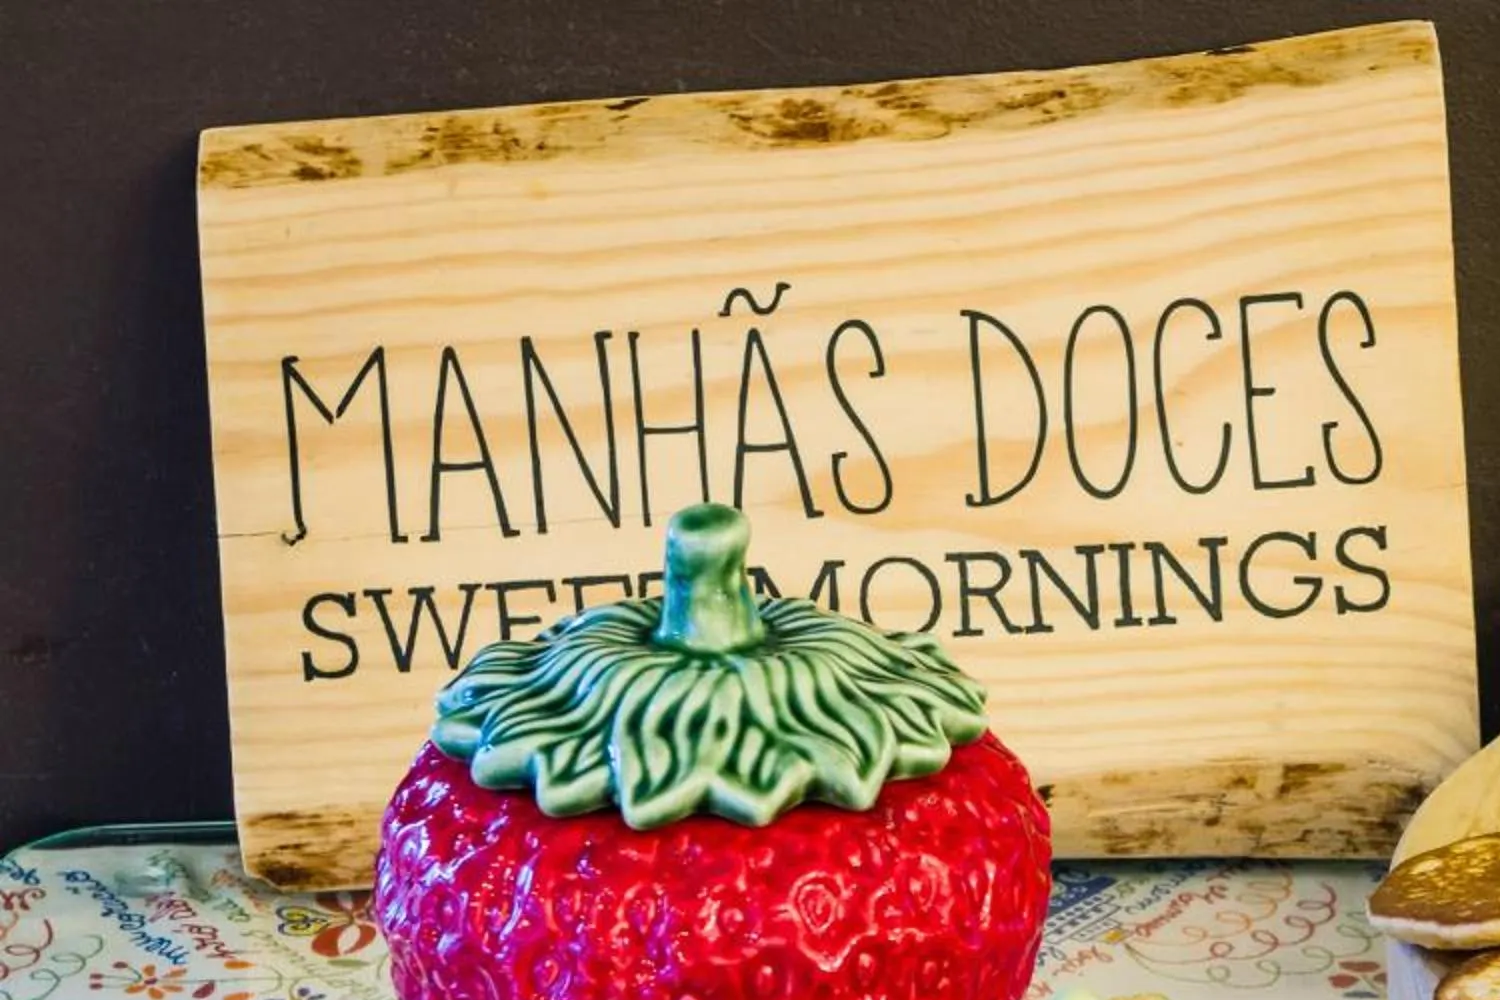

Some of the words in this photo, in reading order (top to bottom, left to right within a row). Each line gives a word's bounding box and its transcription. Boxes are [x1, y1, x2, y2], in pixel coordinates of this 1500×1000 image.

[280, 282, 894, 548] MANHÃS
[959, 290, 1384, 508] DOCES
[301, 570, 668, 682] SWE
